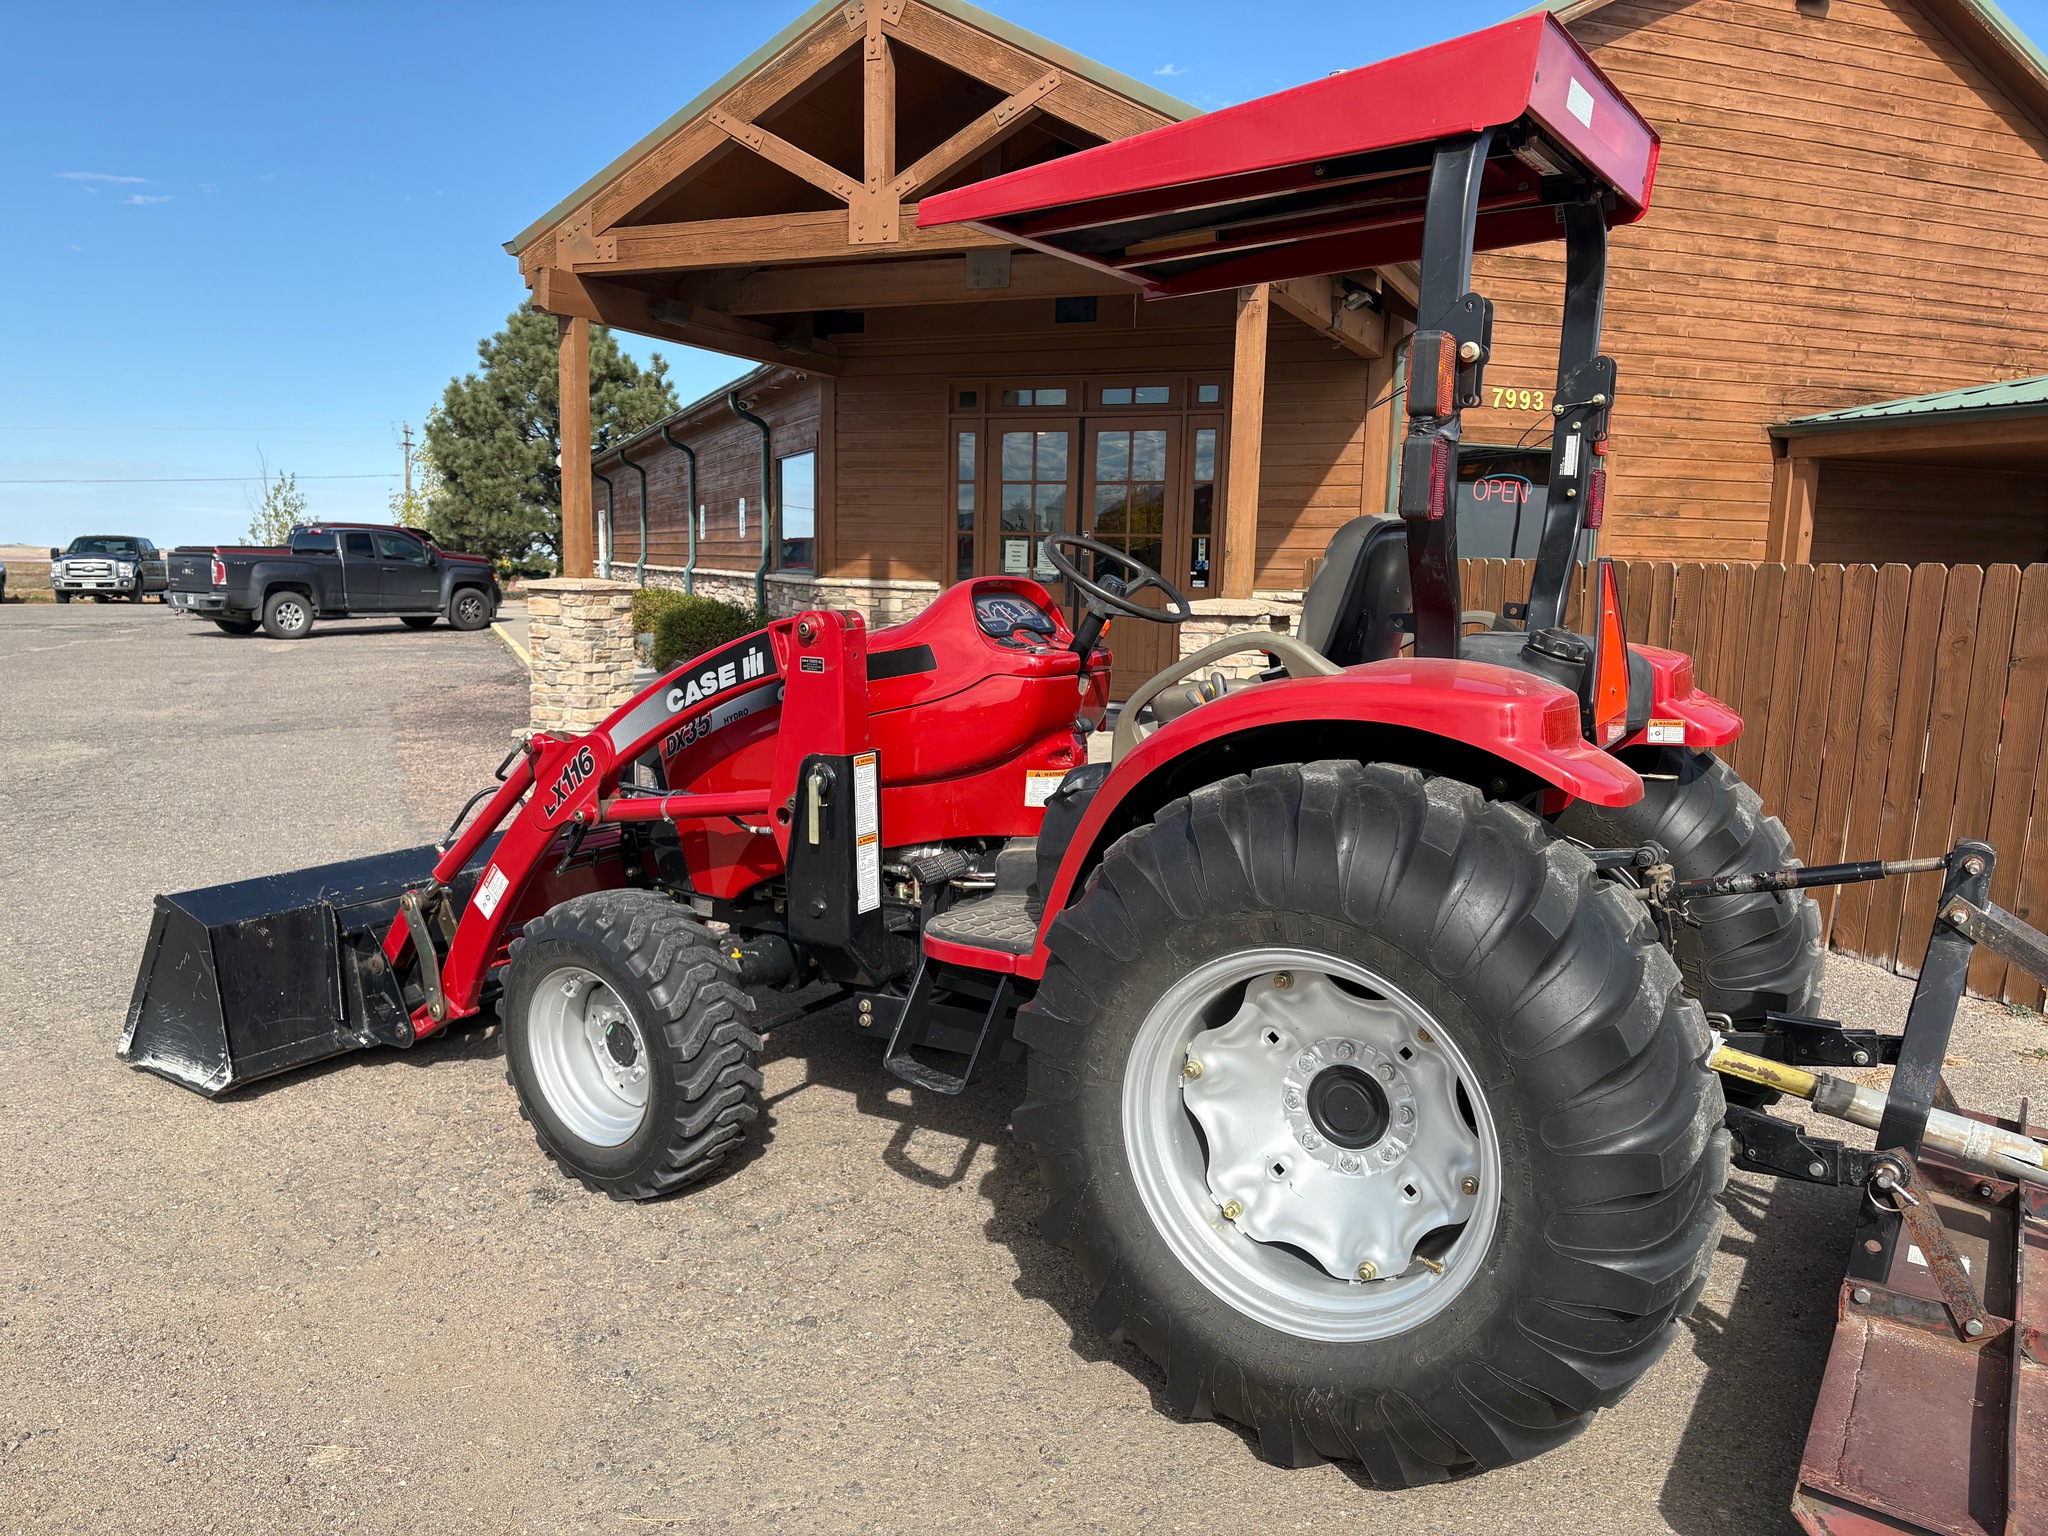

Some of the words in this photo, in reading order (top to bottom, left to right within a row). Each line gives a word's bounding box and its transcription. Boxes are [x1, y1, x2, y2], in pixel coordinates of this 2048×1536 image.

[1492, 387, 1544, 411] 7993
[1473, 478, 1530, 504] OPEN
[666, 660, 737, 713] CASE
[664, 710, 712, 759] DX35
[723, 707, 749, 725] HYDRO
[1180, 1282, 1223, 1321] LUG
[1228, 1318, 1327, 1366] TRACTOR
